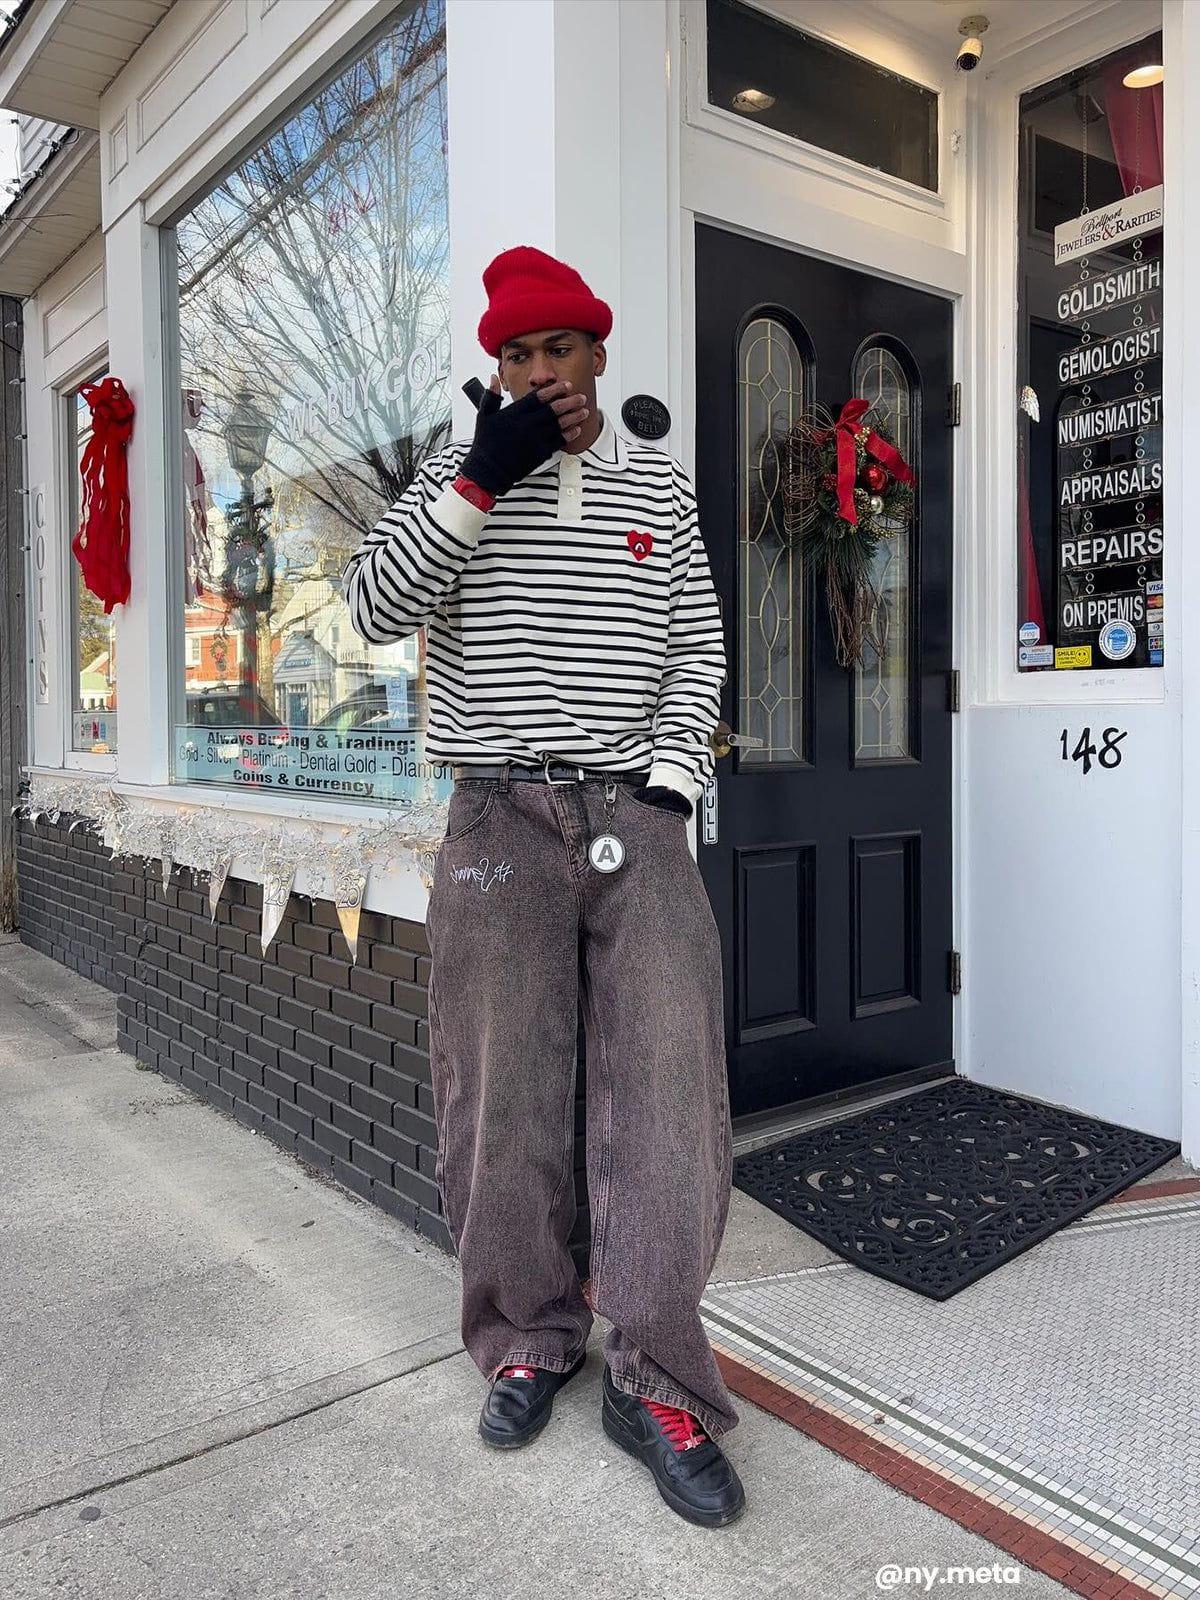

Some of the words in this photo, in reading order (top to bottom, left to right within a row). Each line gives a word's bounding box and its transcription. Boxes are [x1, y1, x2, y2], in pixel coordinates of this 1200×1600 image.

[1056, 231, 1101, 259] JEWELERS
[1102, 224, 1115, 241] &
[1116, 208, 1161, 233] RARITIES
[1057, 261, 1160, 319] GOLDSMITH
[1059, 328, 1160, 382] GEMOLOGIST
[328, 368, 371, 425] BUY
[1058, 396, 1161, 444] NUMISMATIST
[638, 421, 659, 433] BELL
[1061, 463, 1162, 505] APPRAISALS
[1061, 528, 1163, 567] REPAIRS
[36, 492, 47, 696] COINS
[1063, 603, 1083, 627] ON
[207, 732, 253, 747] Always
[258, 733, 310, 751] Buying
[316, 733, 329, 748] &
[335, 735, 416, 755] Trading:
[242, 749, 289, 768] Platinum
[300, 751, 340, 772] Dental
[344, 754, 377, 774] Gold
[1060, 727, 1128, 775] 148
[233, 769, 272, 784] Coins
[278, 773, 290, 786] &
[294, 775, 375, 795] Currency
[706, 780, 715, 841] PULL
